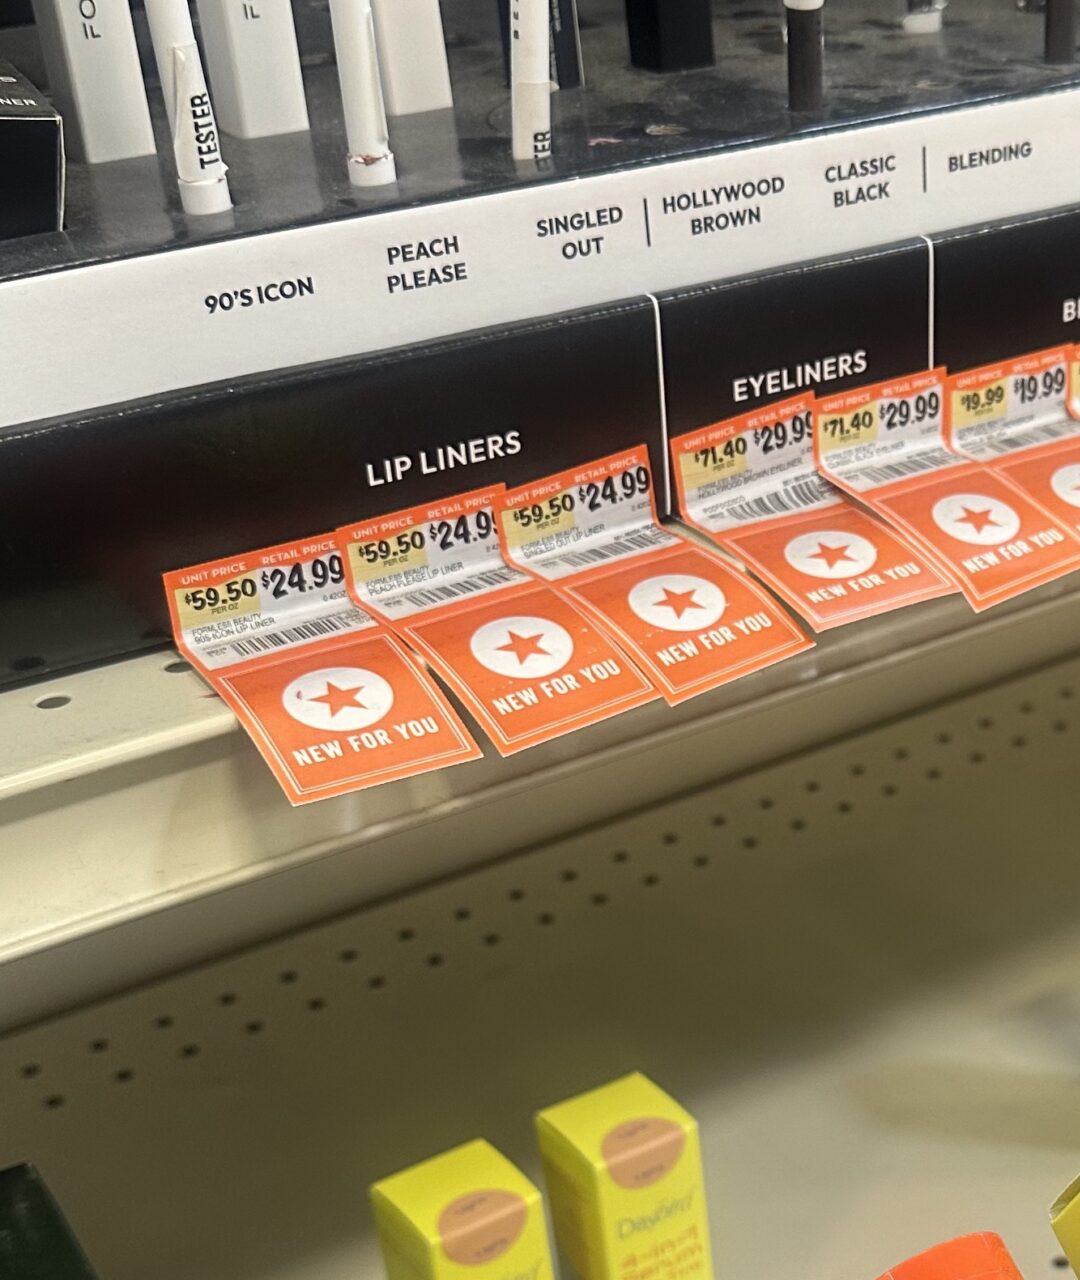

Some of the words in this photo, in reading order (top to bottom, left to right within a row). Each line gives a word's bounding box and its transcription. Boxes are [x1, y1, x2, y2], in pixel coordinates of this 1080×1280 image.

[190, 92, 219, 169] TESTER
[825, 155, 897, 184] CLASSIC
[948, 142, 1032, 172] BLENDING
[663, 177, 785, 214] HOLLYWOOD
[833, 182, 890, 207] BLACK
[536, 206, 624, 238] SINGLED
[691, 207, 761, 236] BROWN
[386, 235, 460, 266] PEACH
[561, 236, 604, 260] OUT
[204, 288, 254, 314] 90'S
[256, 277, 314, 305] ICON
[387, 262, 467, 293] PLEASE
[733, 349, 867, 402] EYELINERS
[1014, 367, 1065, 404] $19.99
[823, 411, 873, 438] $71.40
[880, 392, 940, 431] $29.99
[684, 439, 706, 450] UNIT
[708, 426, 736, 442] PRICE
[694, 437, 748, 468] $71.40
[366, 456, 412, 487] LIP
[420, 431, 522, 475] LINERS
[506, 493, 530, 507] UNIT
[531, 481, 562, 498] PRICE
[574, 467, 608, 483] RETAIL
[609, 455, 638, 471] PRICE
[513, 493, 575, 528] $59.50
[578, 466, 649, 512] $24.99
[353, 526, 379, 540] UNIT
[381, 516, 414, 532] PRICE
[427, 505, 463, 519] RETAIL
[465, 494, 497, 509] PRIC
[181, 573, 208, 585] UNIT
[212, 562, 247, 578] PRICE
[262, 549, 300, 565] RETAIL
[303, 541, 337, 555] PRICE
[358, 531, 426, 563] $59.50
[961, 553, 1000, 576] NEW
[1000, 541, 1032, 563] FOR
[1031, 529, 1066, 551] YOU
[184, 578, 257, 611] $59.50
[261, 554, 345, 600] $24.99
[805, 582, 847, 604] NEW
[849, 571, 884, 592] FOR
[884, 562, 922, 582] YOU
[211, 605, 227, 615] PER
[228, 603, 239, 611] OZ
[233, 613, 262, 627] BEAUTY
[250, 617, 276, 631] LINER
[656, 641, 700, 667] NEW
[701, 627, 737, 651] FOR
[735, 612, 773, 637] YOU
[491, 687, 539, 716] NEW
[540, 672, 580, 700] FOR
[580, 659, 622, 685] YOU
[292, 738, 341, 767] NEW
[347, 728, 394, 753] FOR
[394, 716, 440, 743] YOU
